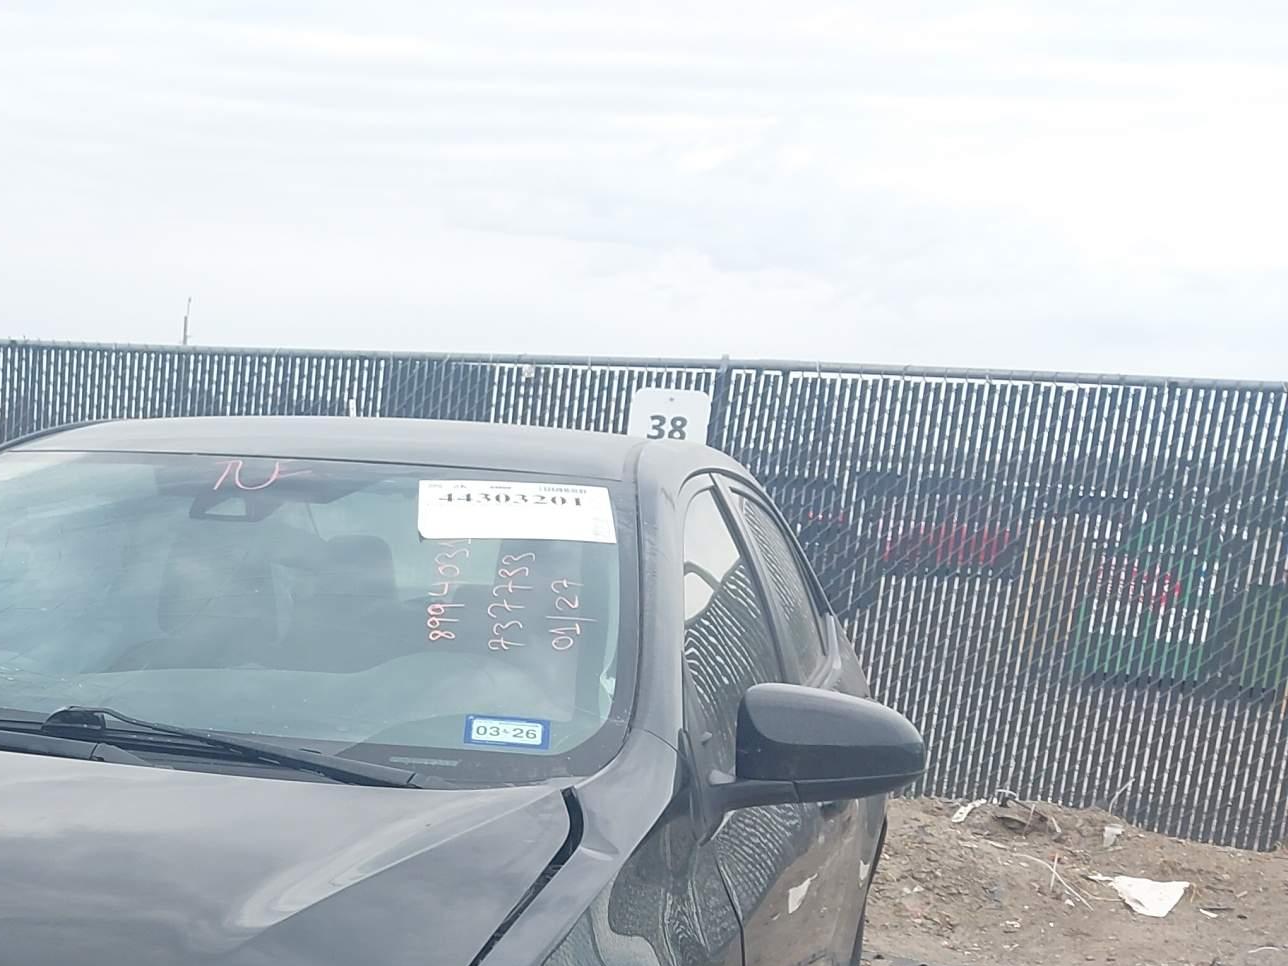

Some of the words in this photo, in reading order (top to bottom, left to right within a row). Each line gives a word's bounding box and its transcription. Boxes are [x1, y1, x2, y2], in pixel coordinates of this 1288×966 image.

[646, 414, 688, 441] 38
[438, 492, 582, 507] 44303201
[544, 578, 599, 651] 01/27
